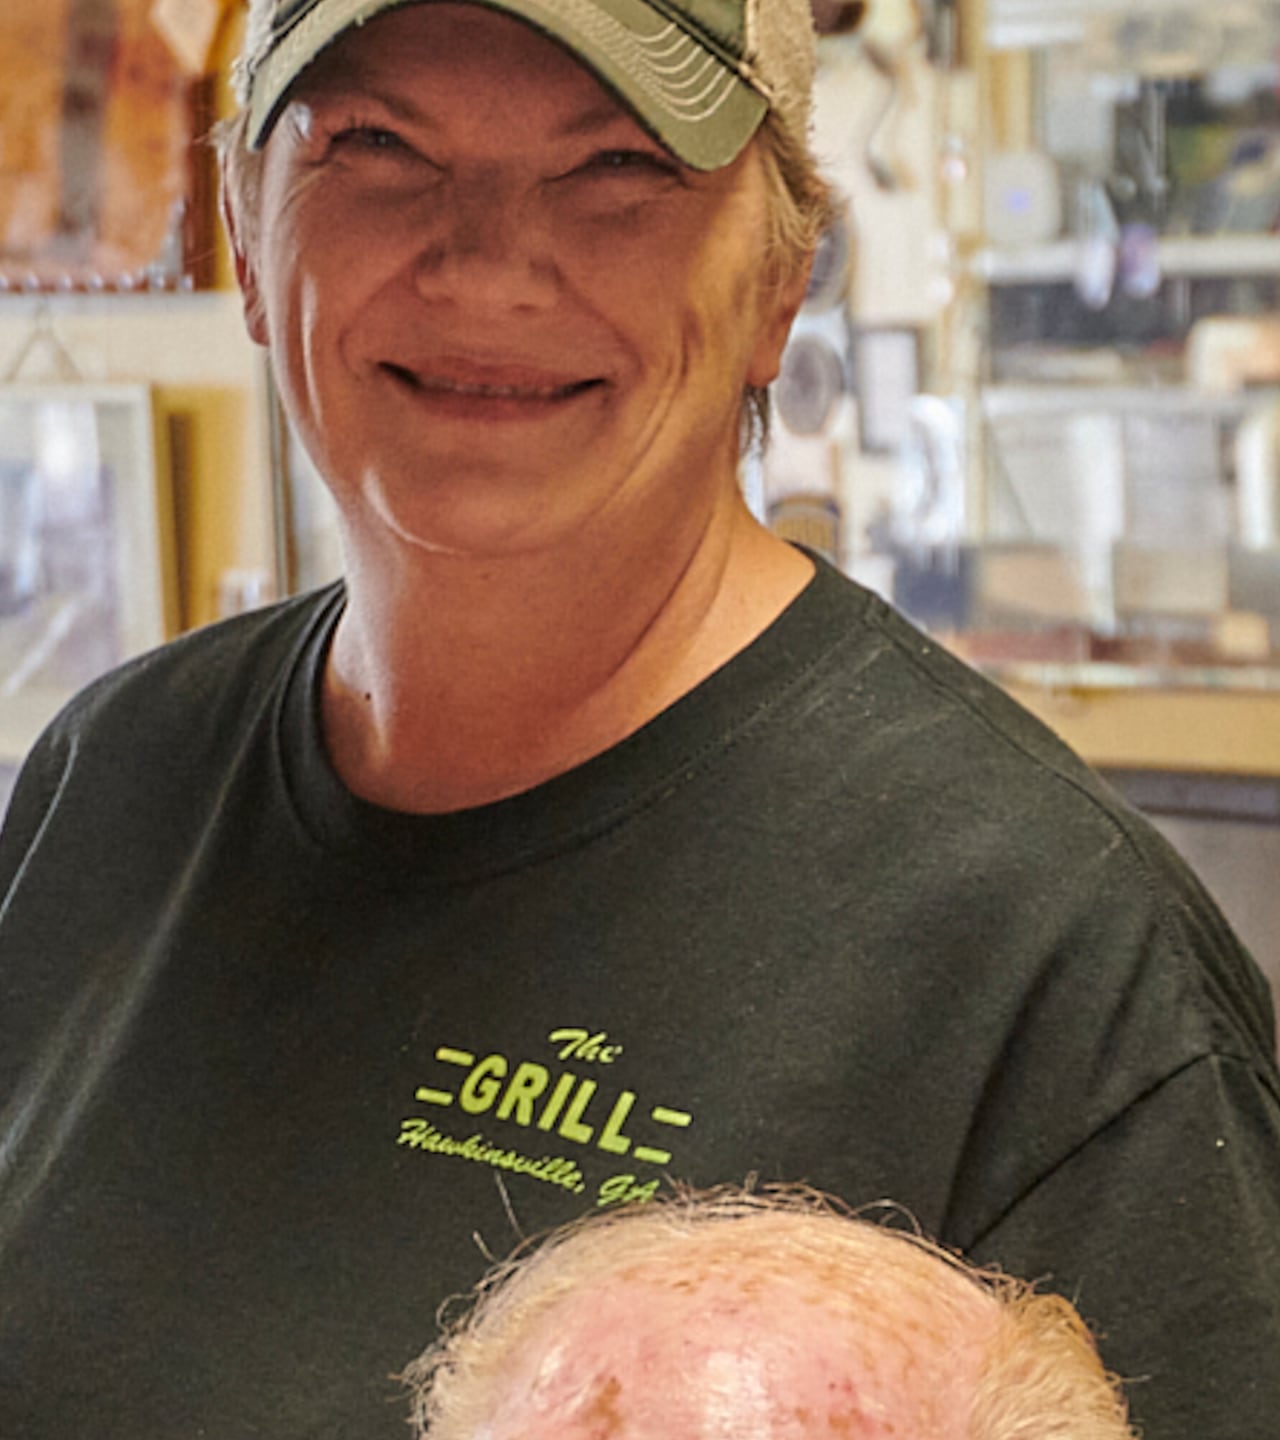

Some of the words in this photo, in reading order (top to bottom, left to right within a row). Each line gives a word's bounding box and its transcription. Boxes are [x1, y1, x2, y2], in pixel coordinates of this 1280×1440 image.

[548, 1027, 623, 1063] The
[458, 1053, 637, 1155] GRILL
[395, 1117, 587, 1195] Hawkinsville,
[595, 1173, 661, 1208] GA
